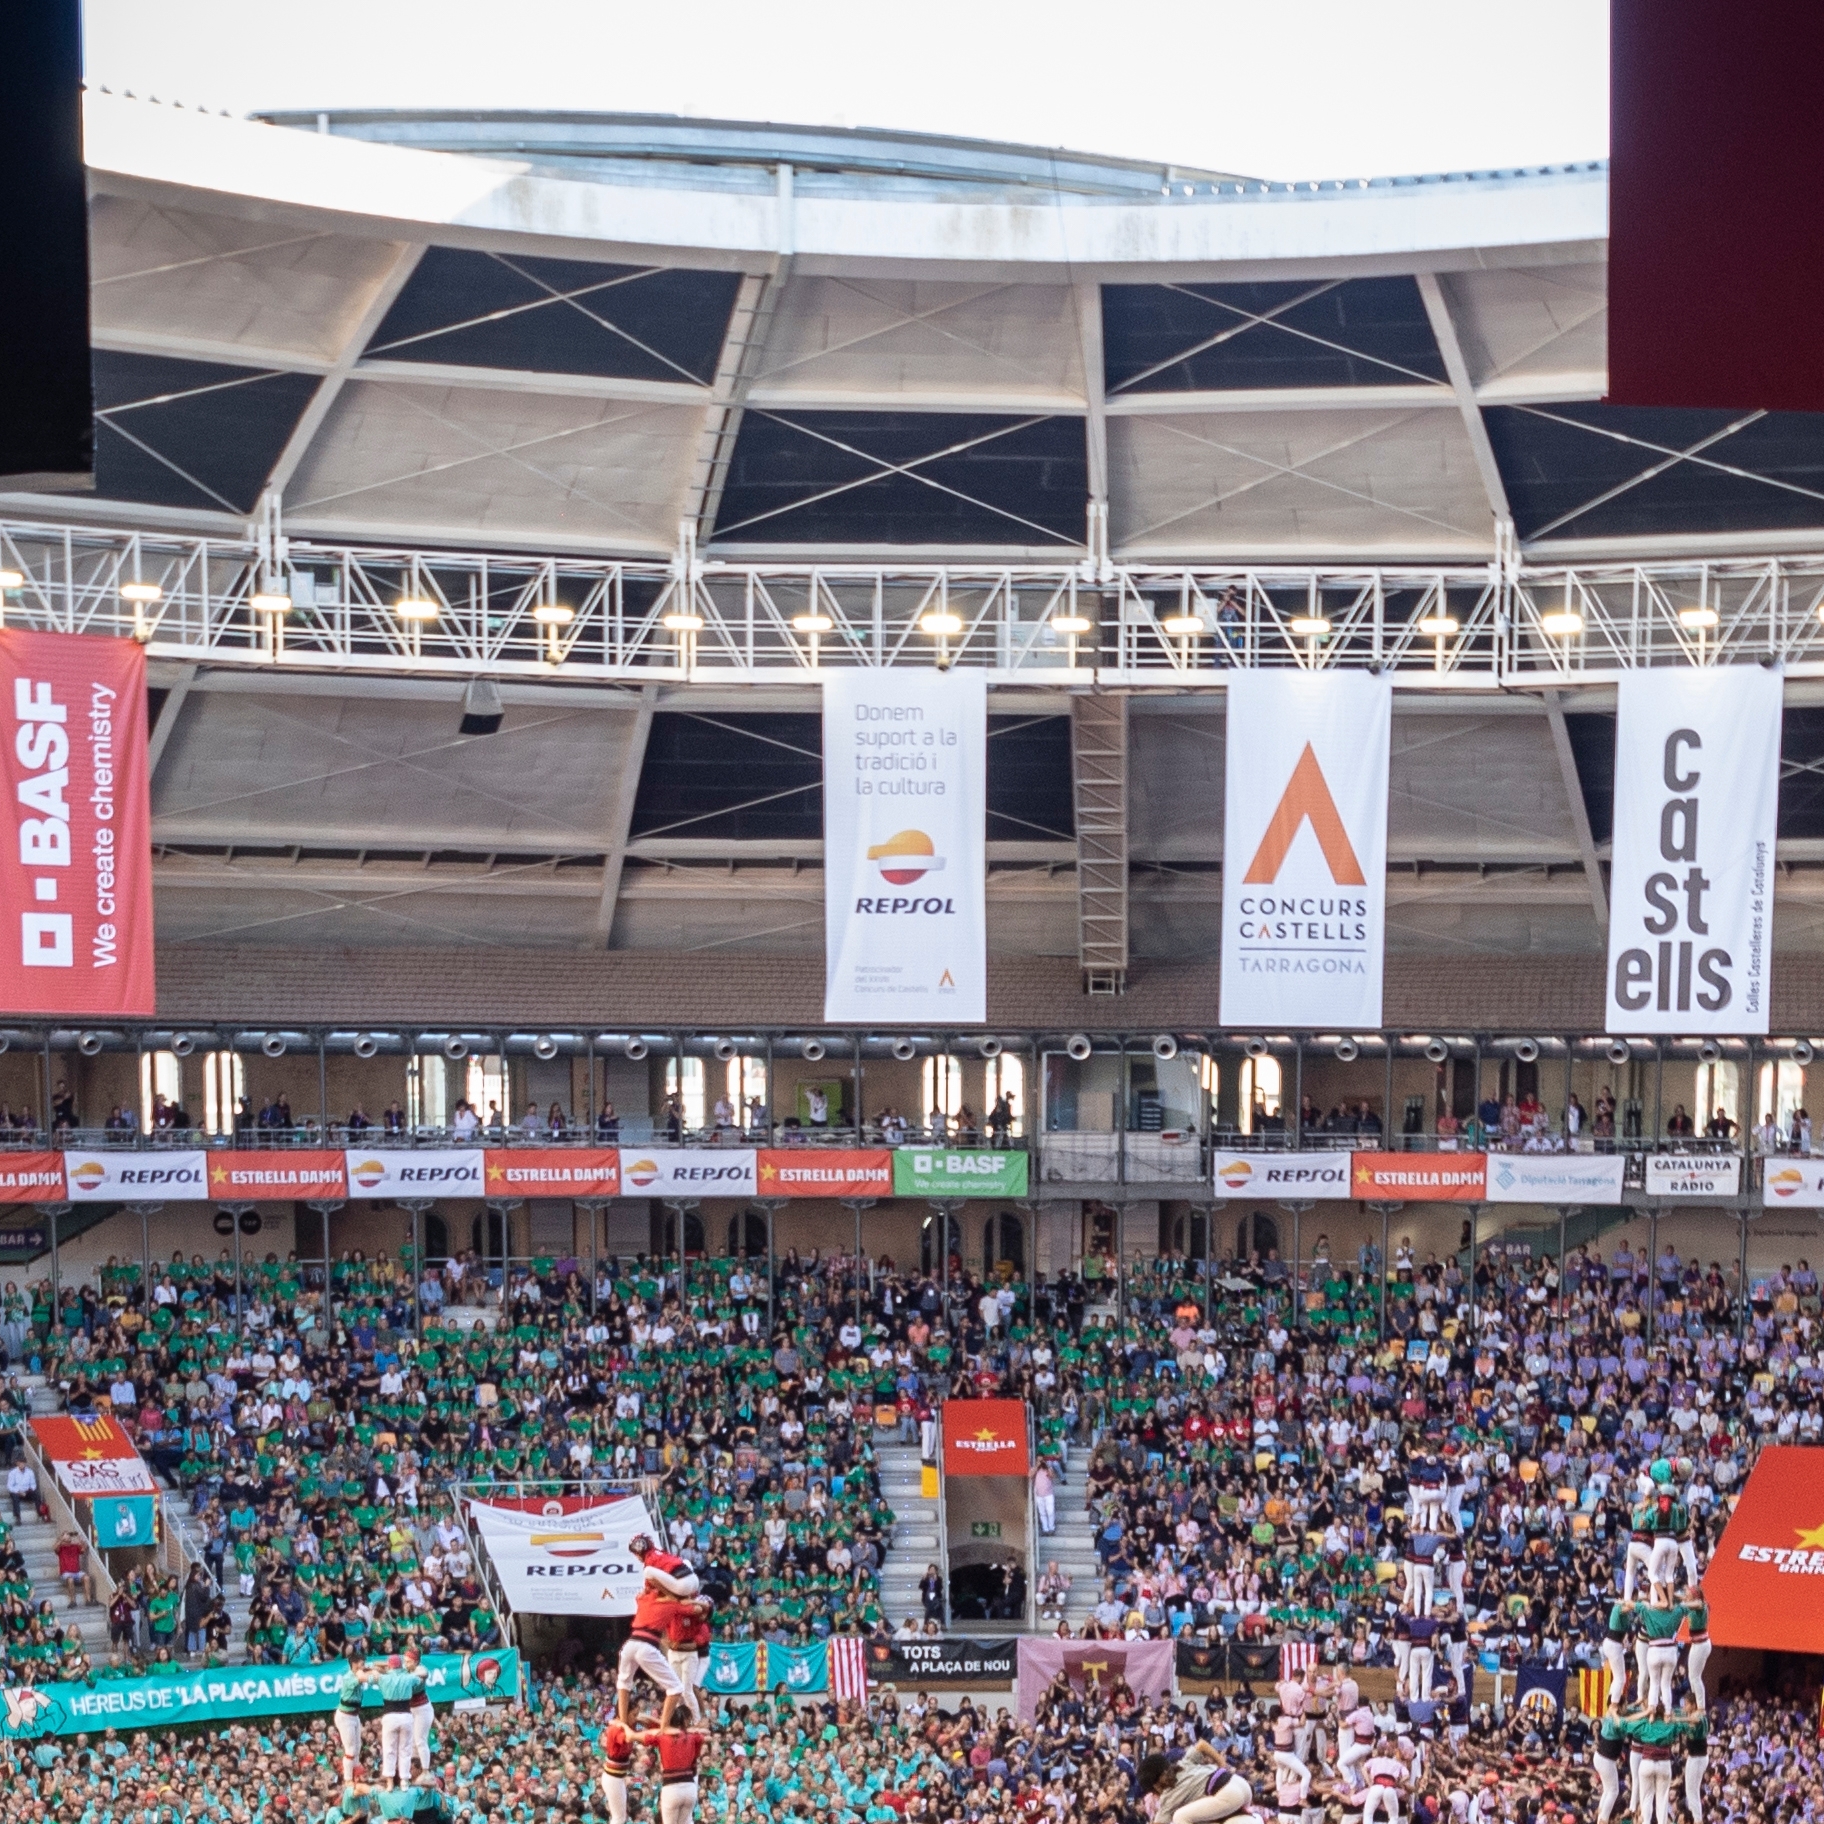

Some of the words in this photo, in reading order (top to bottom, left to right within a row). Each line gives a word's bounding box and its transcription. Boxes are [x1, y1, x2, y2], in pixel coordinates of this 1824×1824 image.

[855, 703, 924, 722] Donem
[855, 729, 918, 750] suport
[922, 731, 936, 746] a
[939, 728, 958, 746] la
[89, 681, 117, 821] chemistry
[855, 752, 928, 772] tradició
[14, 677, 72, 867] BASF
[855, 777, 873, 796] la
[877, 777, 946, 796] cultura
[92, 825, 116, 915] create
[855, 897, 956, 915] REPSOL
[1239, 898, 1367, 917] CONCURS
[1239, 922, 1367, 940] CASTELLS
[92, 922, 117, 969] We
[1239, 957, 1366, 974] TARRAGONA
[946, 1156, 1006, 1174] BASF
[1654, 1160, 1732, 1172] CATALUNYA
[18, 1171, 62, 1186] DAMM
[120, 1168, 203, 1184] REPSOL
[231, 1170, 296, 1184] ESTRELLA
[299, 1169, 343, 1183] DAMM
[399, 1166, 481, 1182] REPSOL
[506, 1168, 571, 1182] ESTRELLA
[574, 1166, 616, 1182] DAMM
[673, 1166, 754, 1181] REPSOL
[779, 1168, 845, 1182] ESTRELLA
[847, 1167, 889, 1181] DAMM
[1266, 1167, 1347, 1183] REPSOL
[1375, 1171, 1439, 1185] ESTRELLA
[1441, 1171, 1484, 1185] DAMM
[0, 1234, 25, 1246] BAR
[955, 1440, 1016, 1449] ESTRELLA
[526, 1564, 639, 1576] REPSOL
[902, 1645, 941, 1659] TOTS
[910, 1662, 920, 1673] A
[921, 1661, 963, 1675] PLAÇA
[964, 1661, 981, 1673] DE
[984, 1660, 1010, 1673] NOU
[71, 1691, 145, 1716] HEREUS
[148, 1689, 172, 1709] DE
[209, 1680, 271, 1704] PLAÇA
[279, 1673, 317, 1697] MÉS
